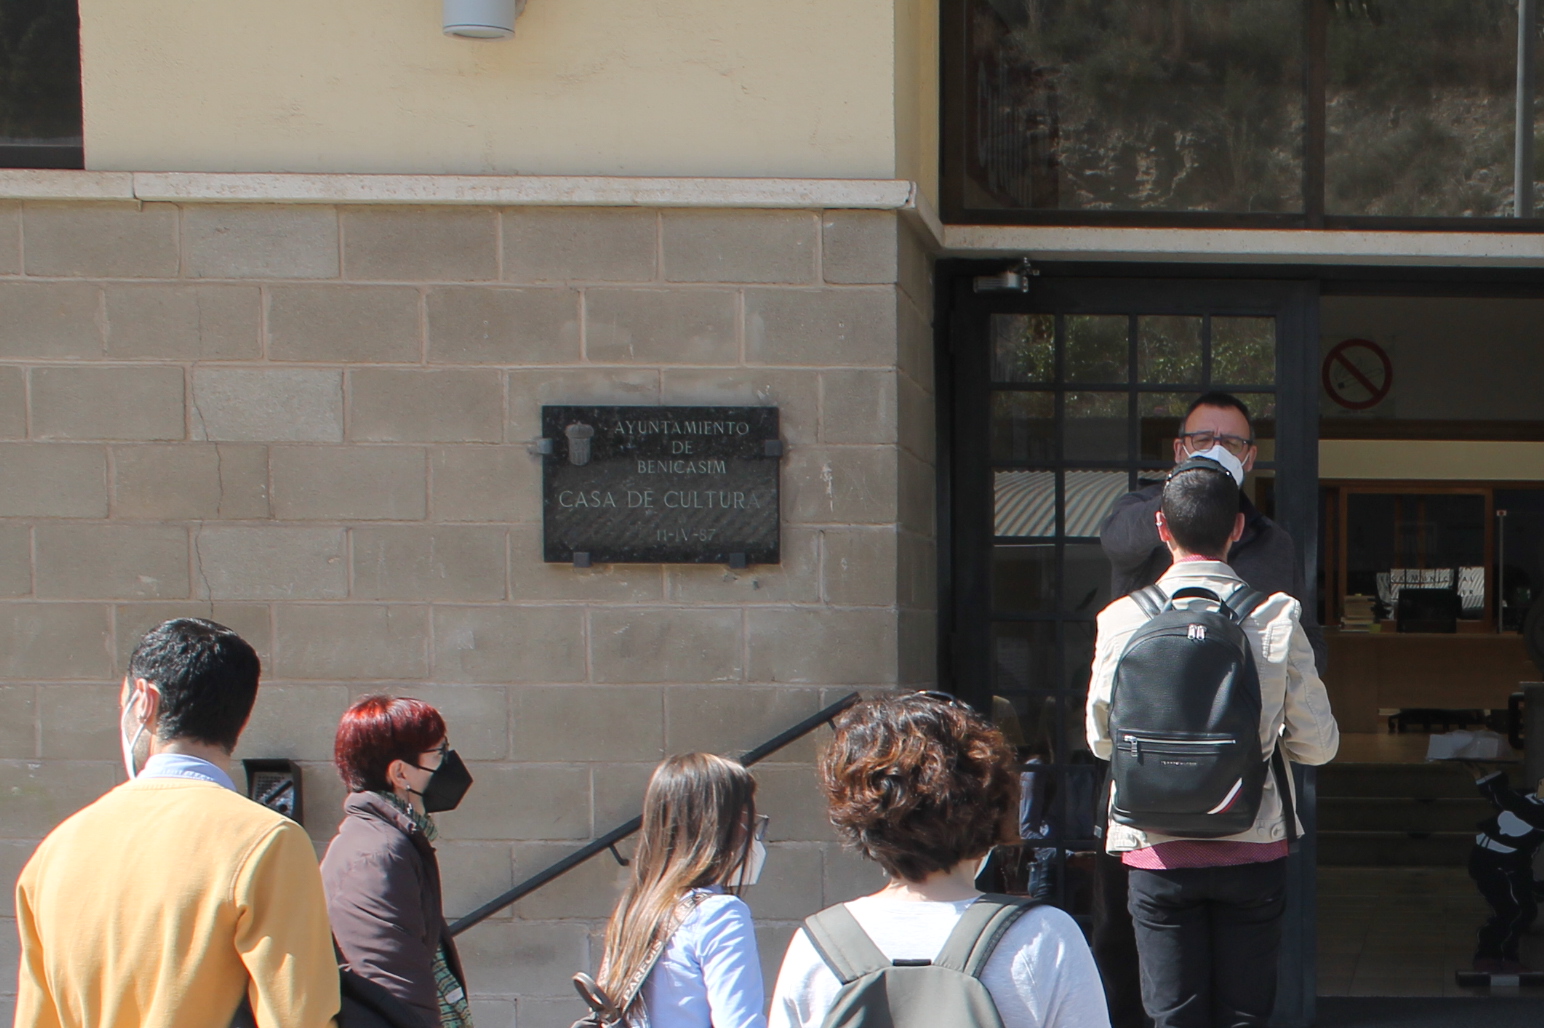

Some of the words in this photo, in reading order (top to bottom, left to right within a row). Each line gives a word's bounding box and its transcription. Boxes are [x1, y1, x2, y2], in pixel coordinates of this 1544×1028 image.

[614, 420, 750, 435] AYUNTAMIENTO
[671, 440, 693, 455] DE
[637, 460, 727, 474] BENICASIM
[559, 490, 616, 508] CASA
[628, 490, 654, 508] DE
[664, 490, 761, 509] CULTURA
